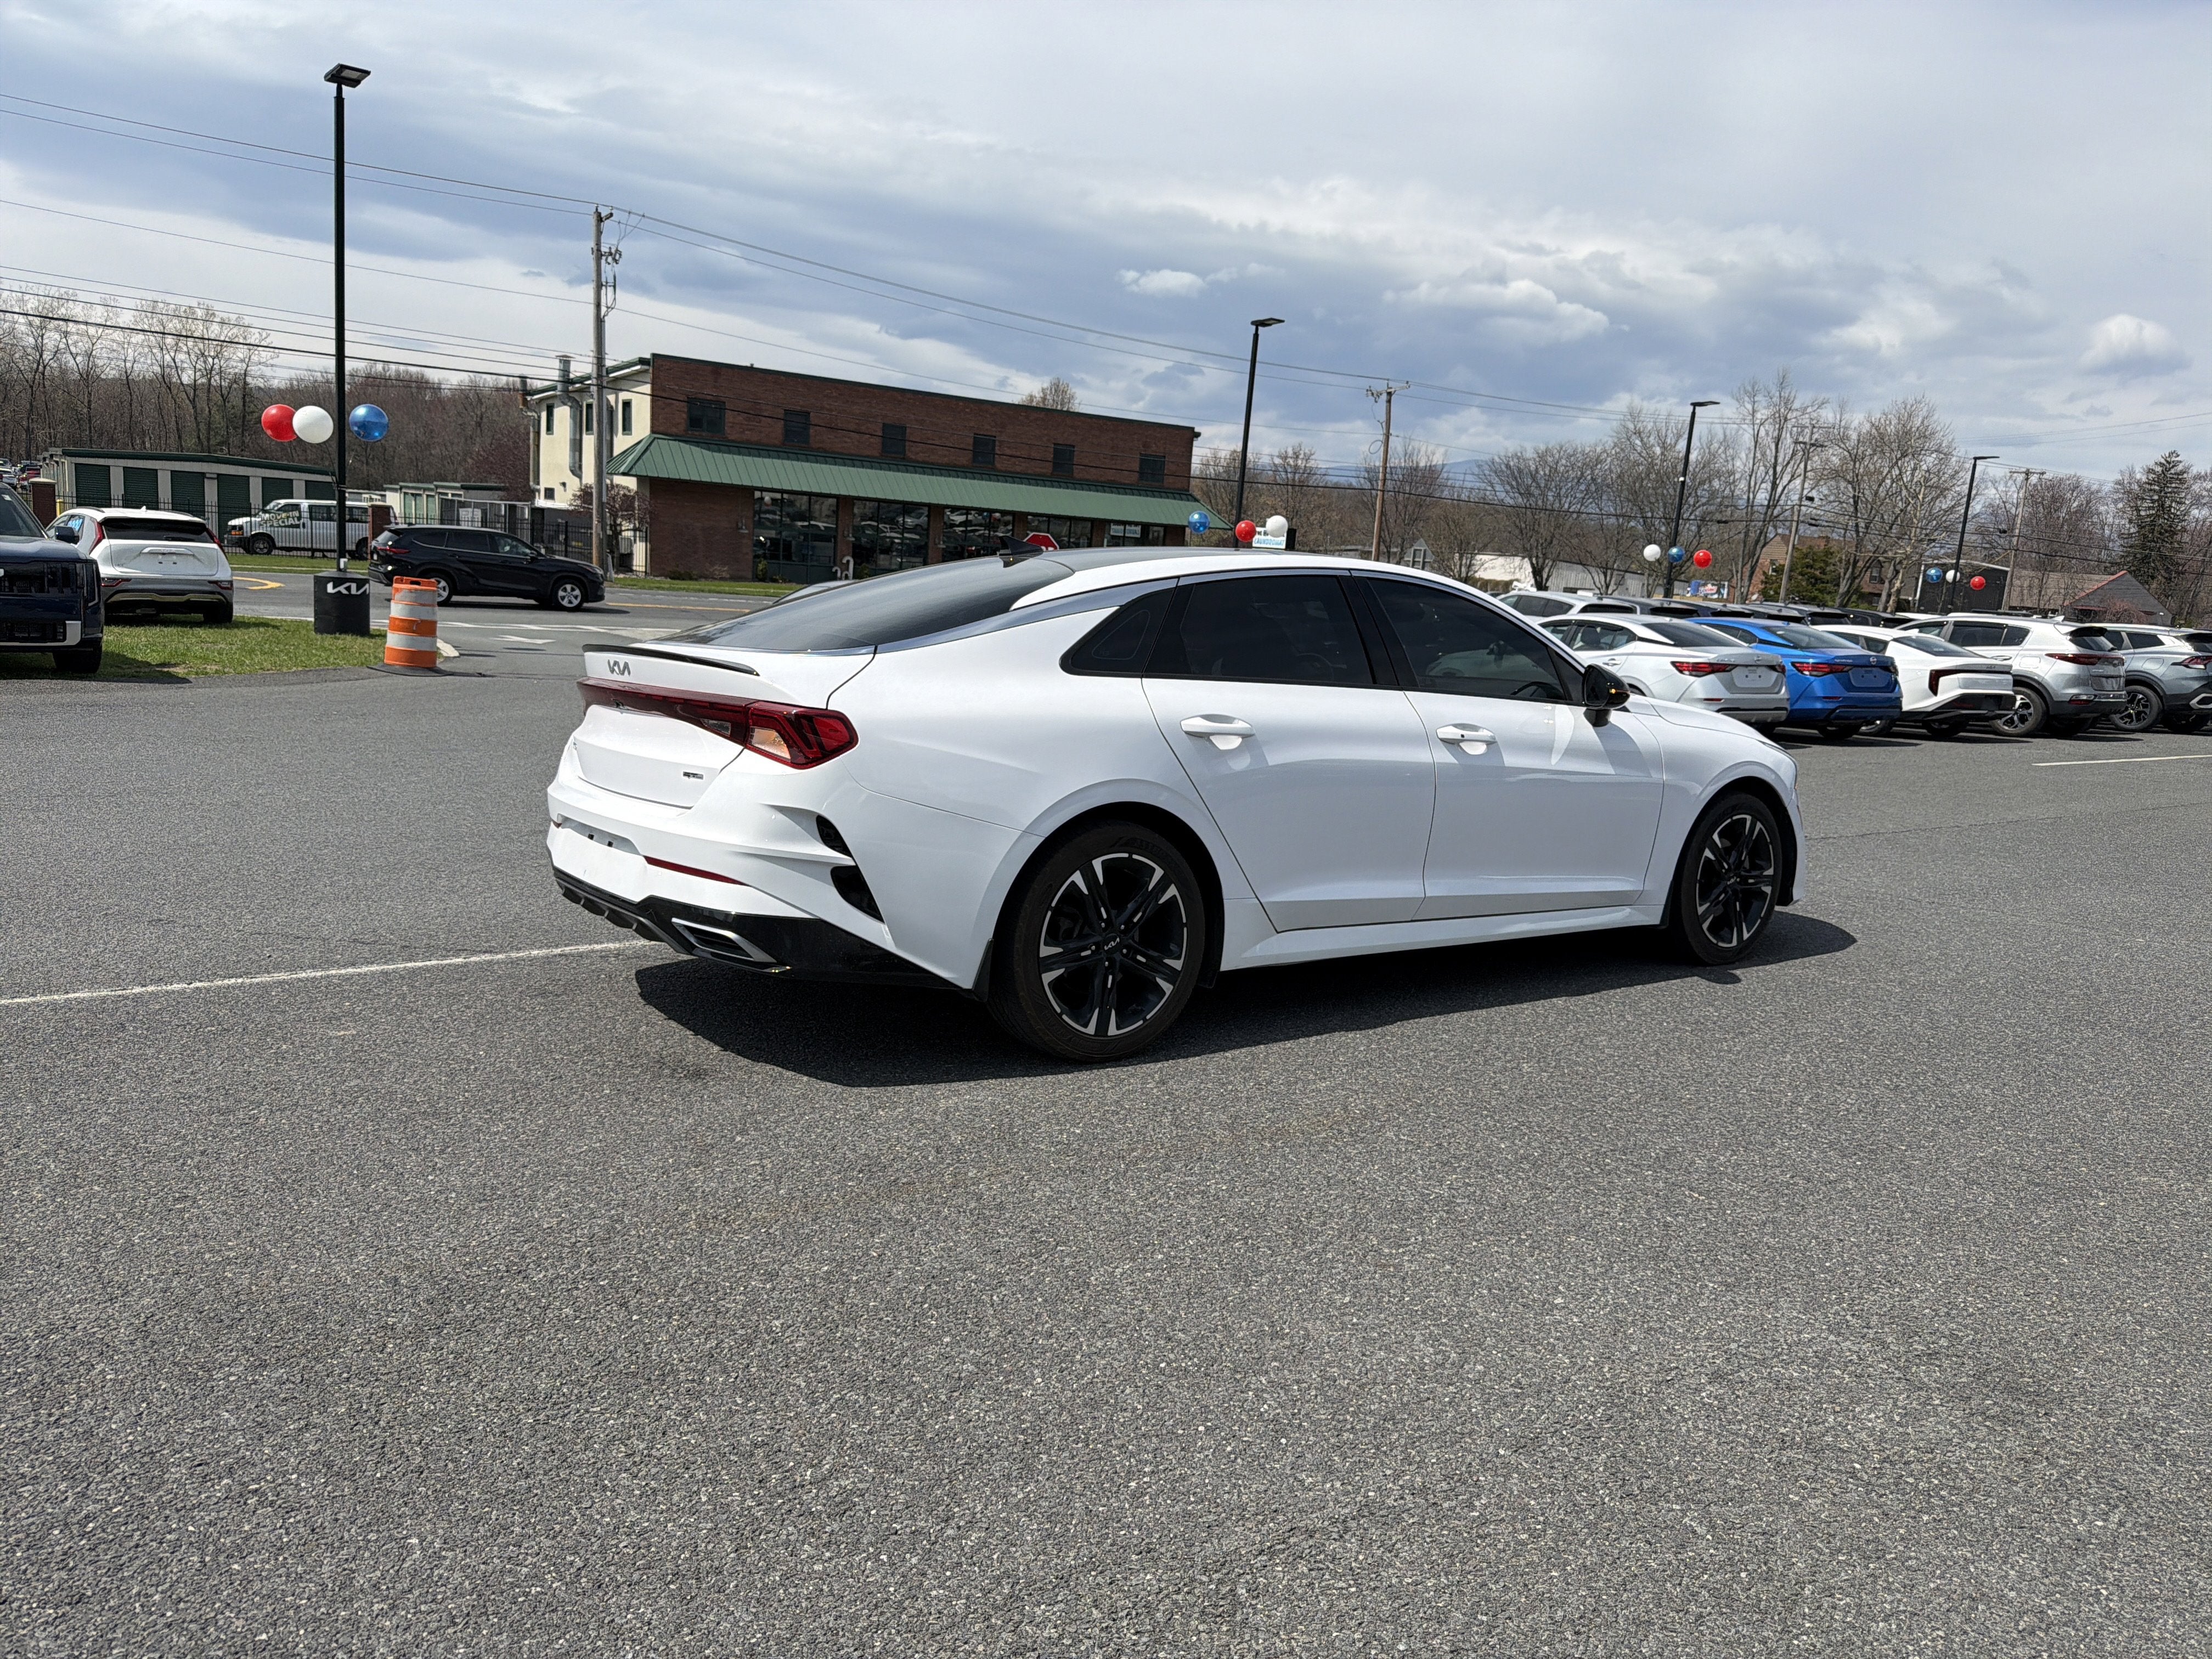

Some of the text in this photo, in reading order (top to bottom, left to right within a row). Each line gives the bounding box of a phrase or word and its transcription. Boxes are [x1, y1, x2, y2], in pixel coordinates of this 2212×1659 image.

[260, 517, 301, 527] SPECIAL
[261, 510, 300, 521] MOVE-IN
[326, 582, 369, 595] KIA
[607, 658, 631, 676] KIA
[1104, 937, 1120, 950] KIA
